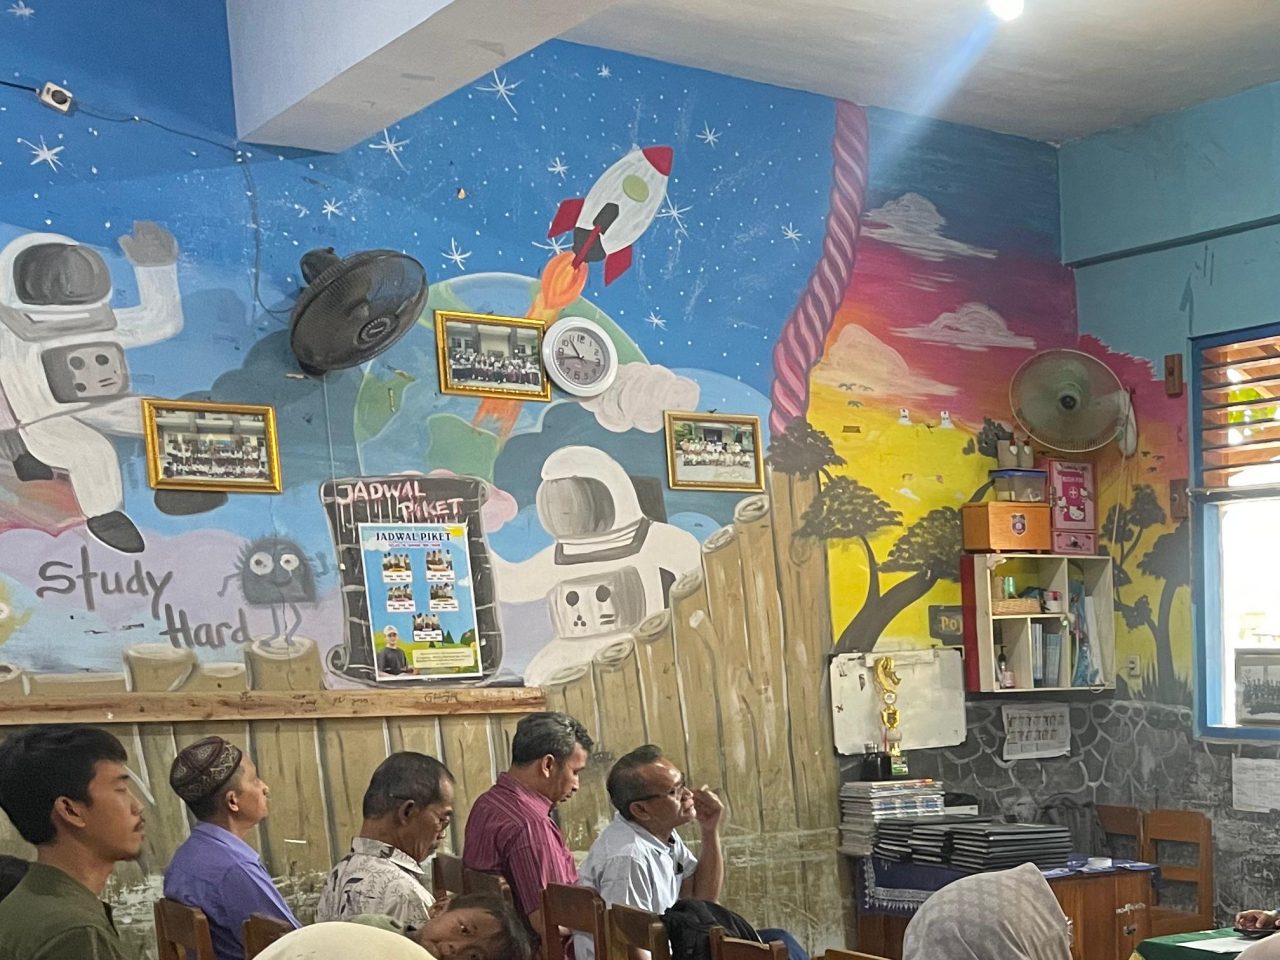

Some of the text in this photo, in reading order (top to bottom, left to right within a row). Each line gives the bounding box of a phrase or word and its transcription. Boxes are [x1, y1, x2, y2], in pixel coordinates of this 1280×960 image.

[338, 480, 427, 503] JADWAL
[399, 498, 464, 521] PIKET
[376, 532, 451, 542] JADWAL PIKET
[36, 545, 173, 619] Study
[159, 603, 253, 650] Hard
